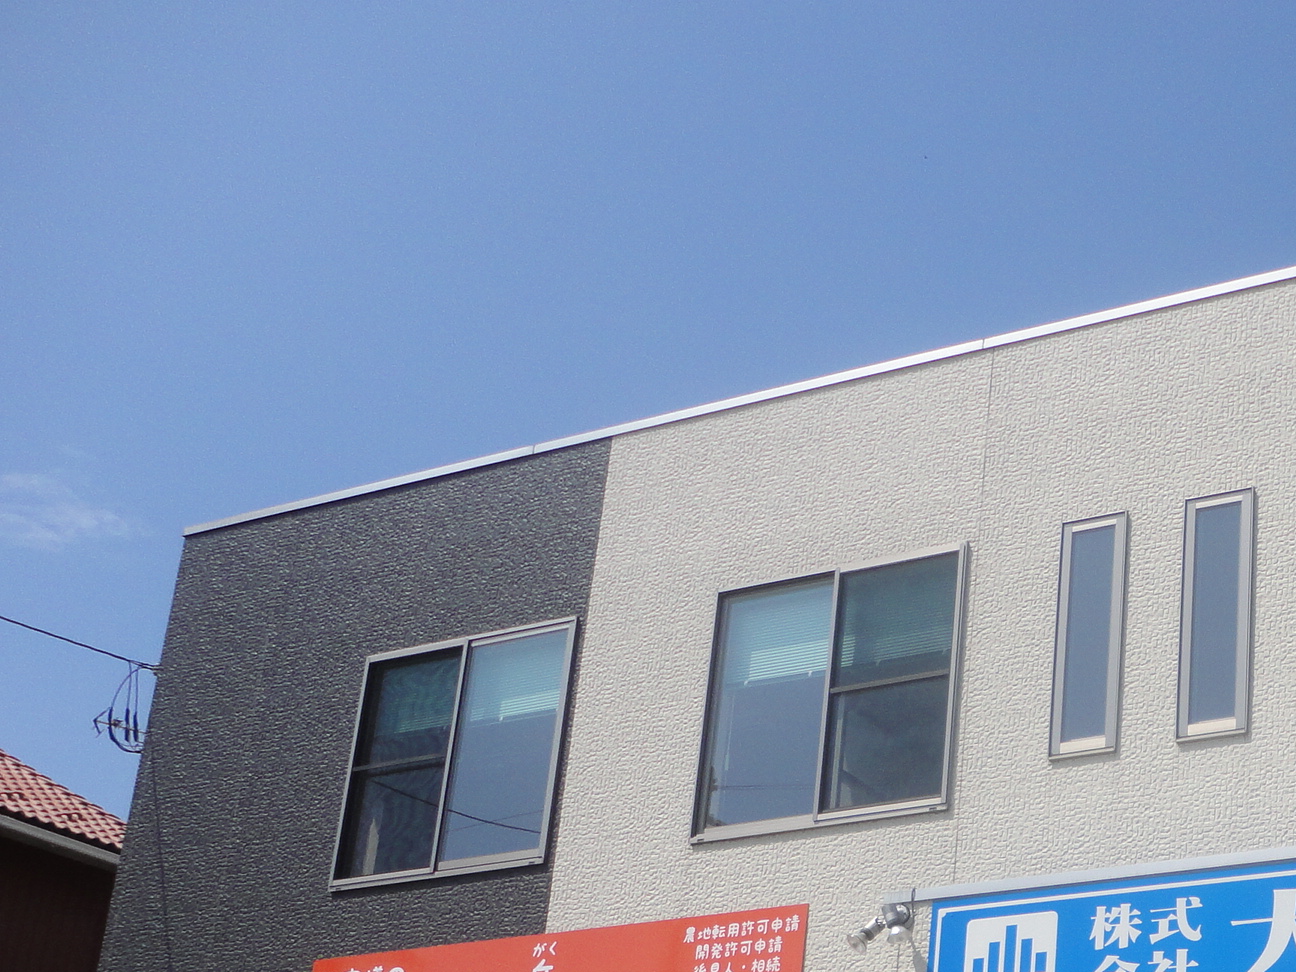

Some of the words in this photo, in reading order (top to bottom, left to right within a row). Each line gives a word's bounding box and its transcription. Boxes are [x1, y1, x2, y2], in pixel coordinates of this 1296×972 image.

[683, 914, 800, 944] 農地転用許可申請
[1089, 896, 1203, 950] 株式
[532, 941, 558, 957] がく
[695, 936, 783, 960] 開発許可申請
